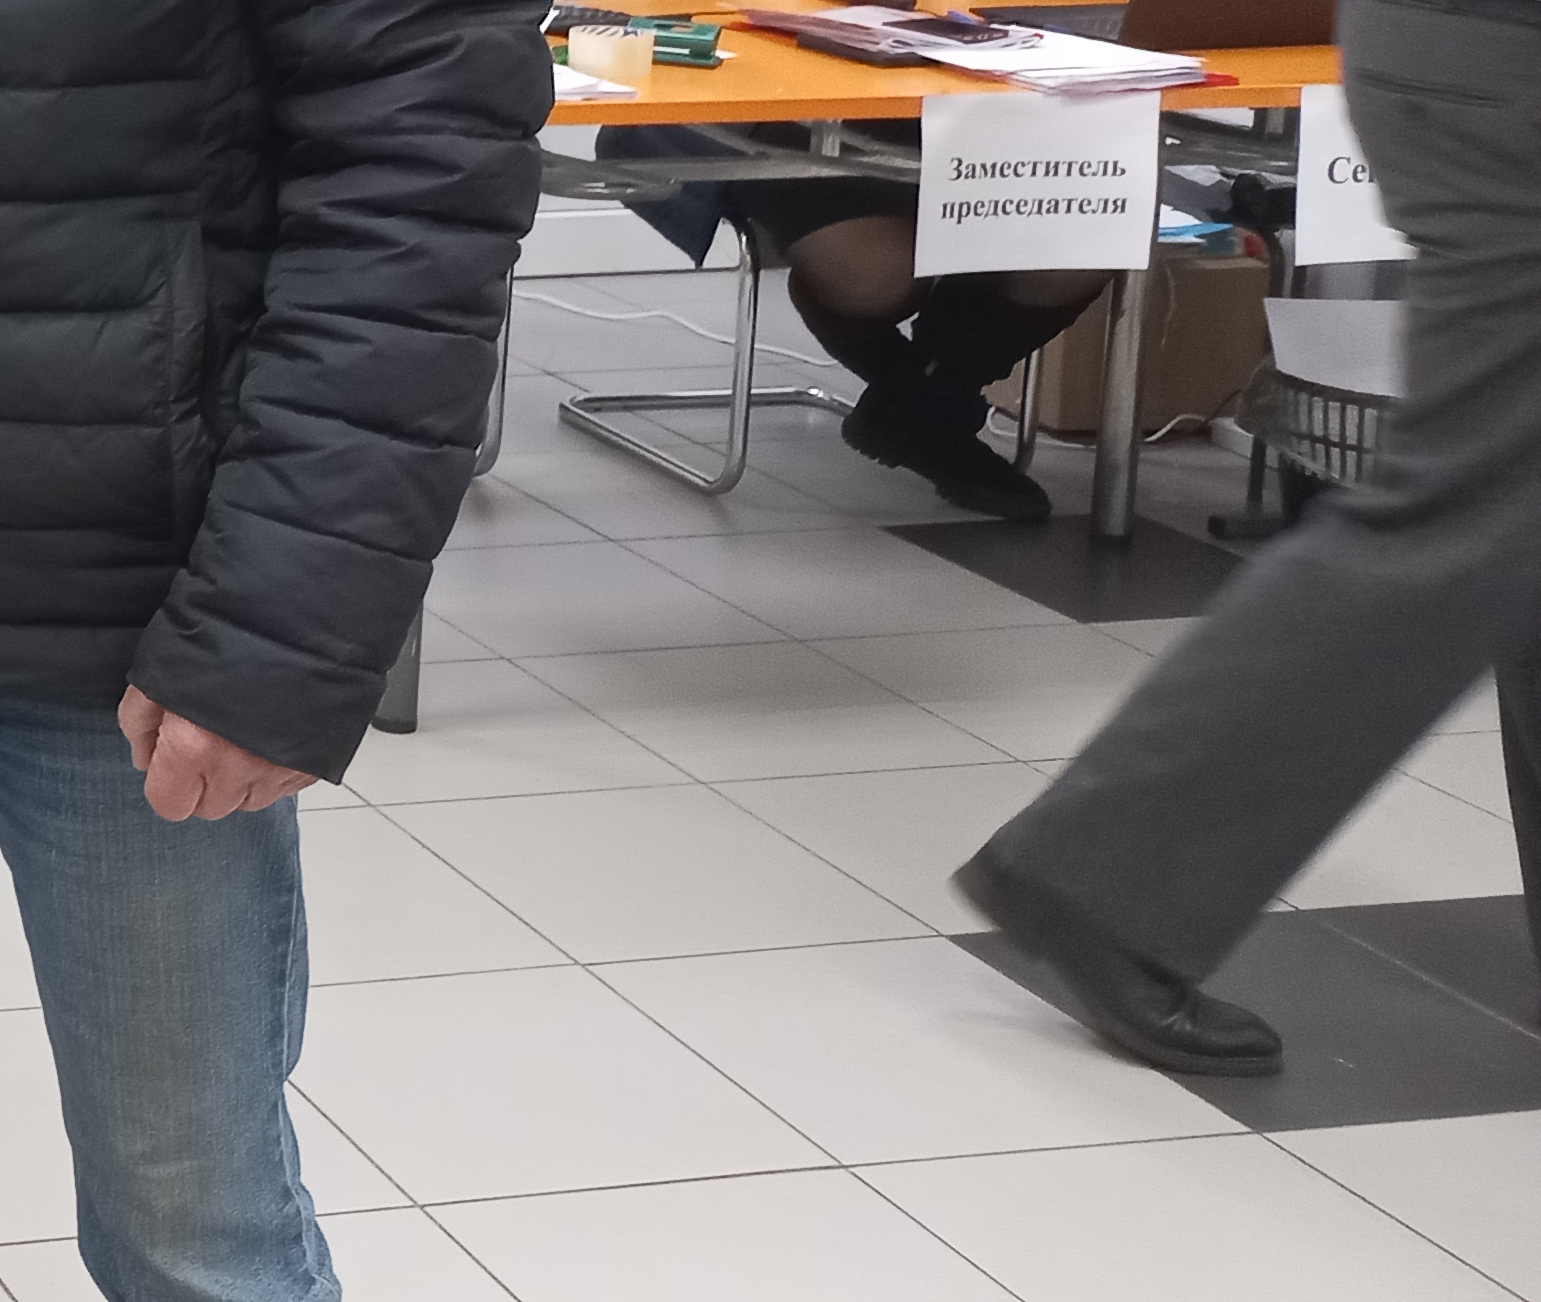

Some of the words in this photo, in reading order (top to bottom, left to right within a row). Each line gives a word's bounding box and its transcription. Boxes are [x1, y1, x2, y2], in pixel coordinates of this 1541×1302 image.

[948, 157, 1127, 182] Заместитель
[1327, 156, 1376, 185] Се
[941, 197, 1127, 225] председателя
